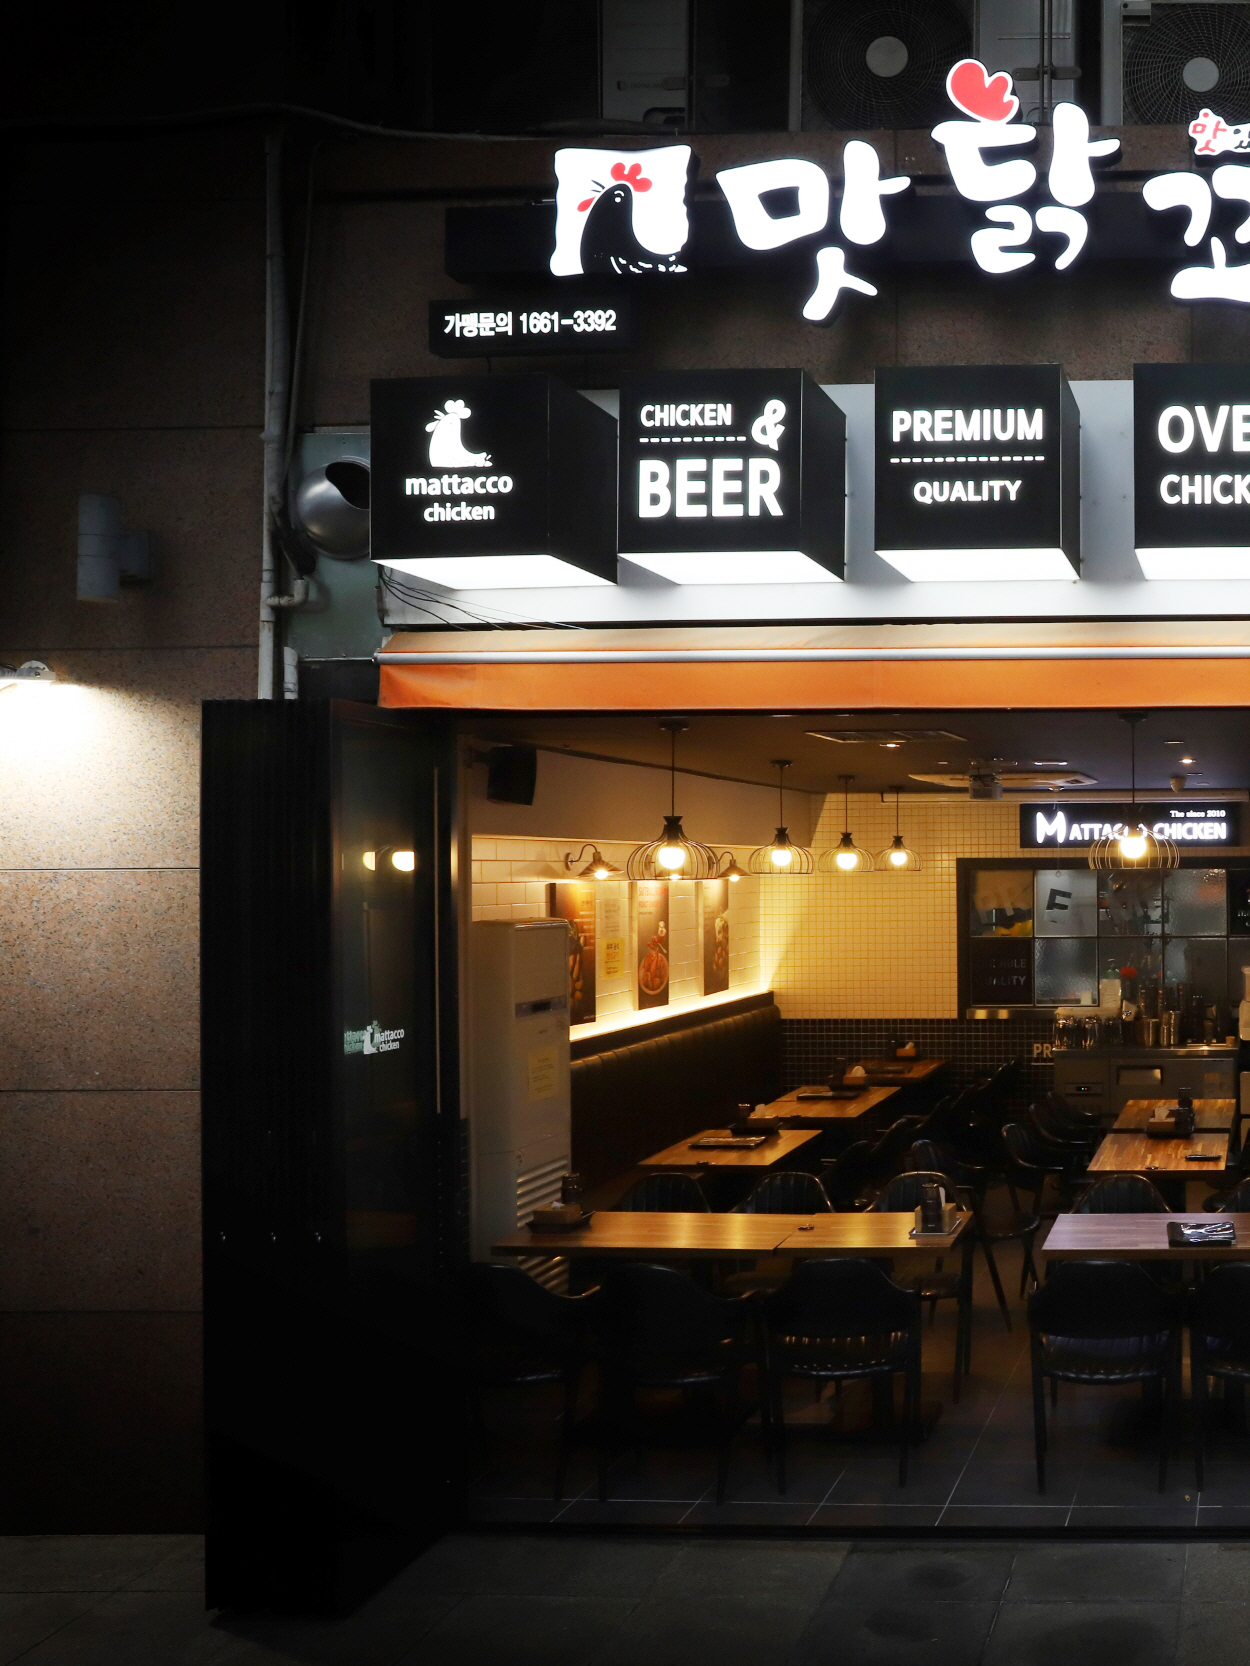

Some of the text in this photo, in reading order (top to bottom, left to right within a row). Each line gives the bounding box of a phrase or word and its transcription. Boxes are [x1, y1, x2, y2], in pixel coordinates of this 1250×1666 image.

[444, 310, 617, 337] 가맹문의 1661-3392
[640, 399, 787, 451] CHICKEN &
[892, 409, 1044, 443] PREMIUM
[405, 473, 514, 496] mattacco
[638, 458, 784, 519] BEER
[913, 480, 1023, 505] QUALITY
[423, 502, 496, 522] chicken
[1170, 810, 1226, 818] The since 2010
[1152, 822, 1227, 840] CHICKEN
[977, 975, 1027, 986] UALITY
[374, 1029, 405, 1043] mattacco
